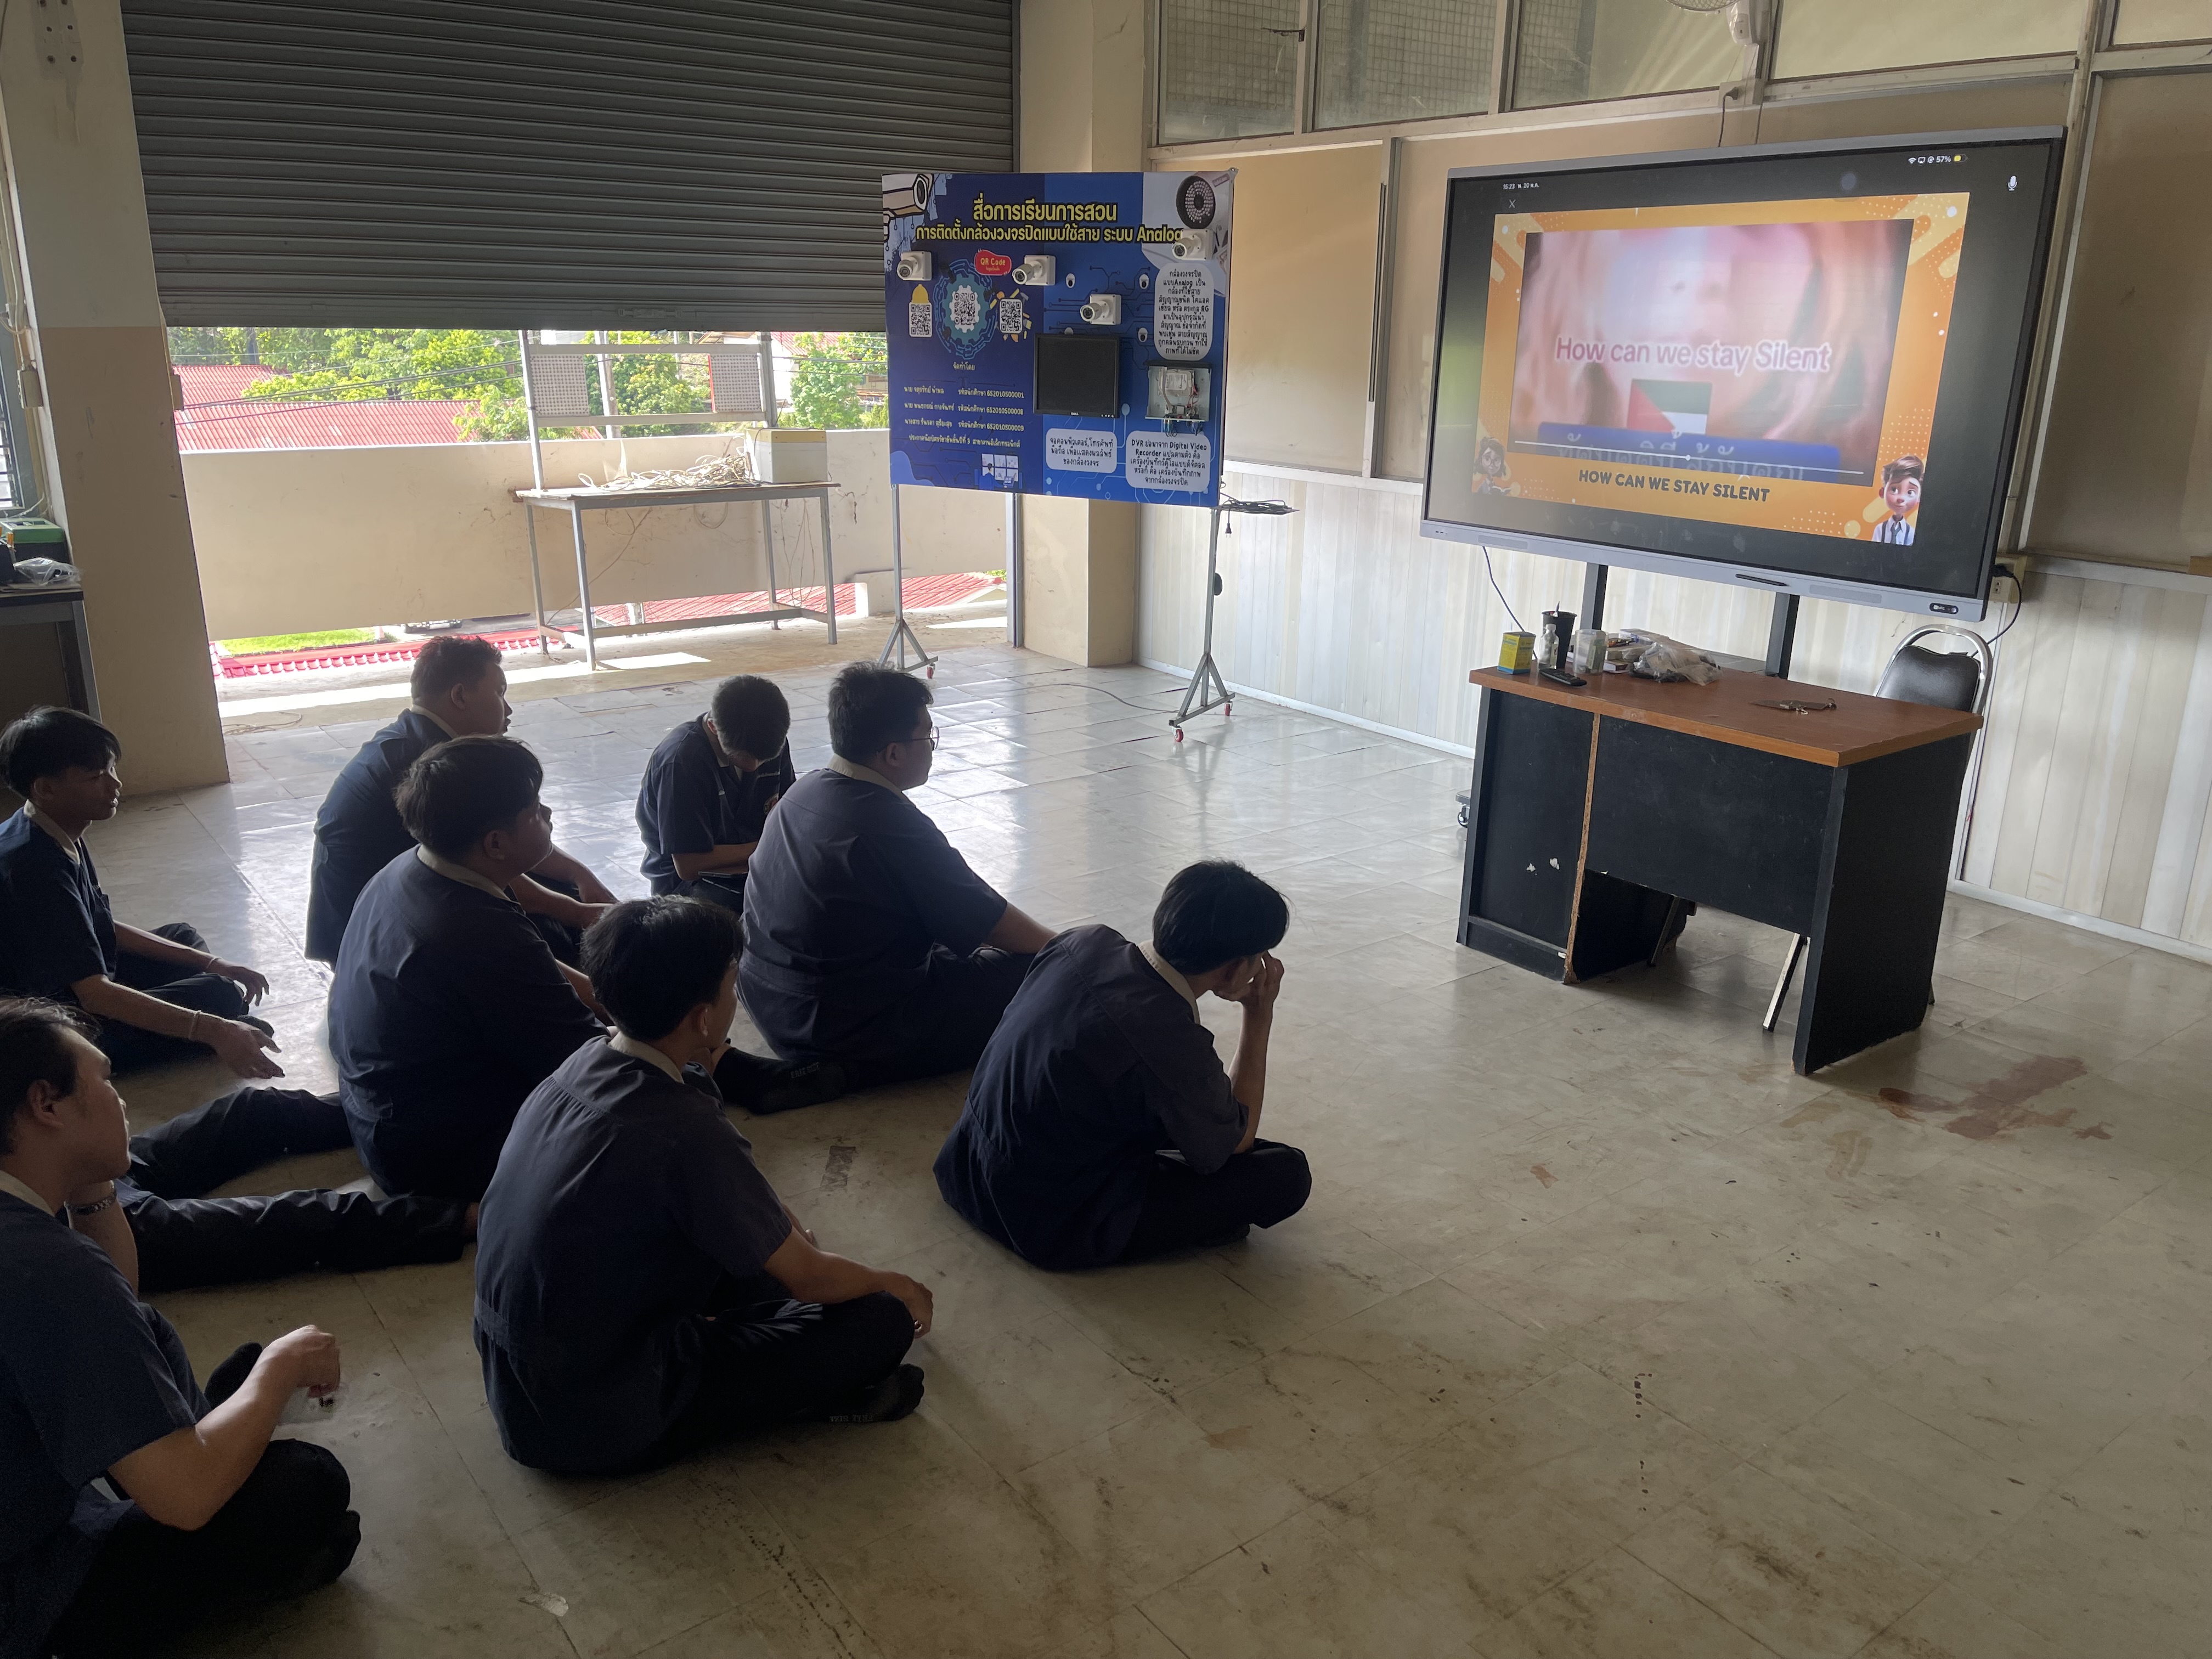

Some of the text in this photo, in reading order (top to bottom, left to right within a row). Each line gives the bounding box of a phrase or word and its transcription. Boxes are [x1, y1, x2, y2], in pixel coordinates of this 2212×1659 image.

[973, 193, 1117, 221] สื่อการเรียนการสอน
[916, 218, 1100, 241] การติดตั้งกล้องวงจรปิดแบบใช้สาย
[1104, 228, 1133, 241] ระบบ
[980, 257, 989, 266] QR
[1556, 336, 1831, 377] How can we stay Silent
[953, 362, 975, 371] จัดทำโดย
[958, 387, 986, 396] รหัสนักศึกษา
[986, 390, 1024, 398] 652010500001
[957, 404, 986, 413] รหัสนักศึกษา
[958, 420, 986, 429] รหัสนักศึกษา
[986, 423, 1024, 431] 652010500009
[1170, 442, 1188, 450] Digital
[1190, 442, 1207, 450] Video
[1136, 448, 1161, 456] Recorder
[1579, 469, 1770, 502] HOW CAN WE STAY SILENT
